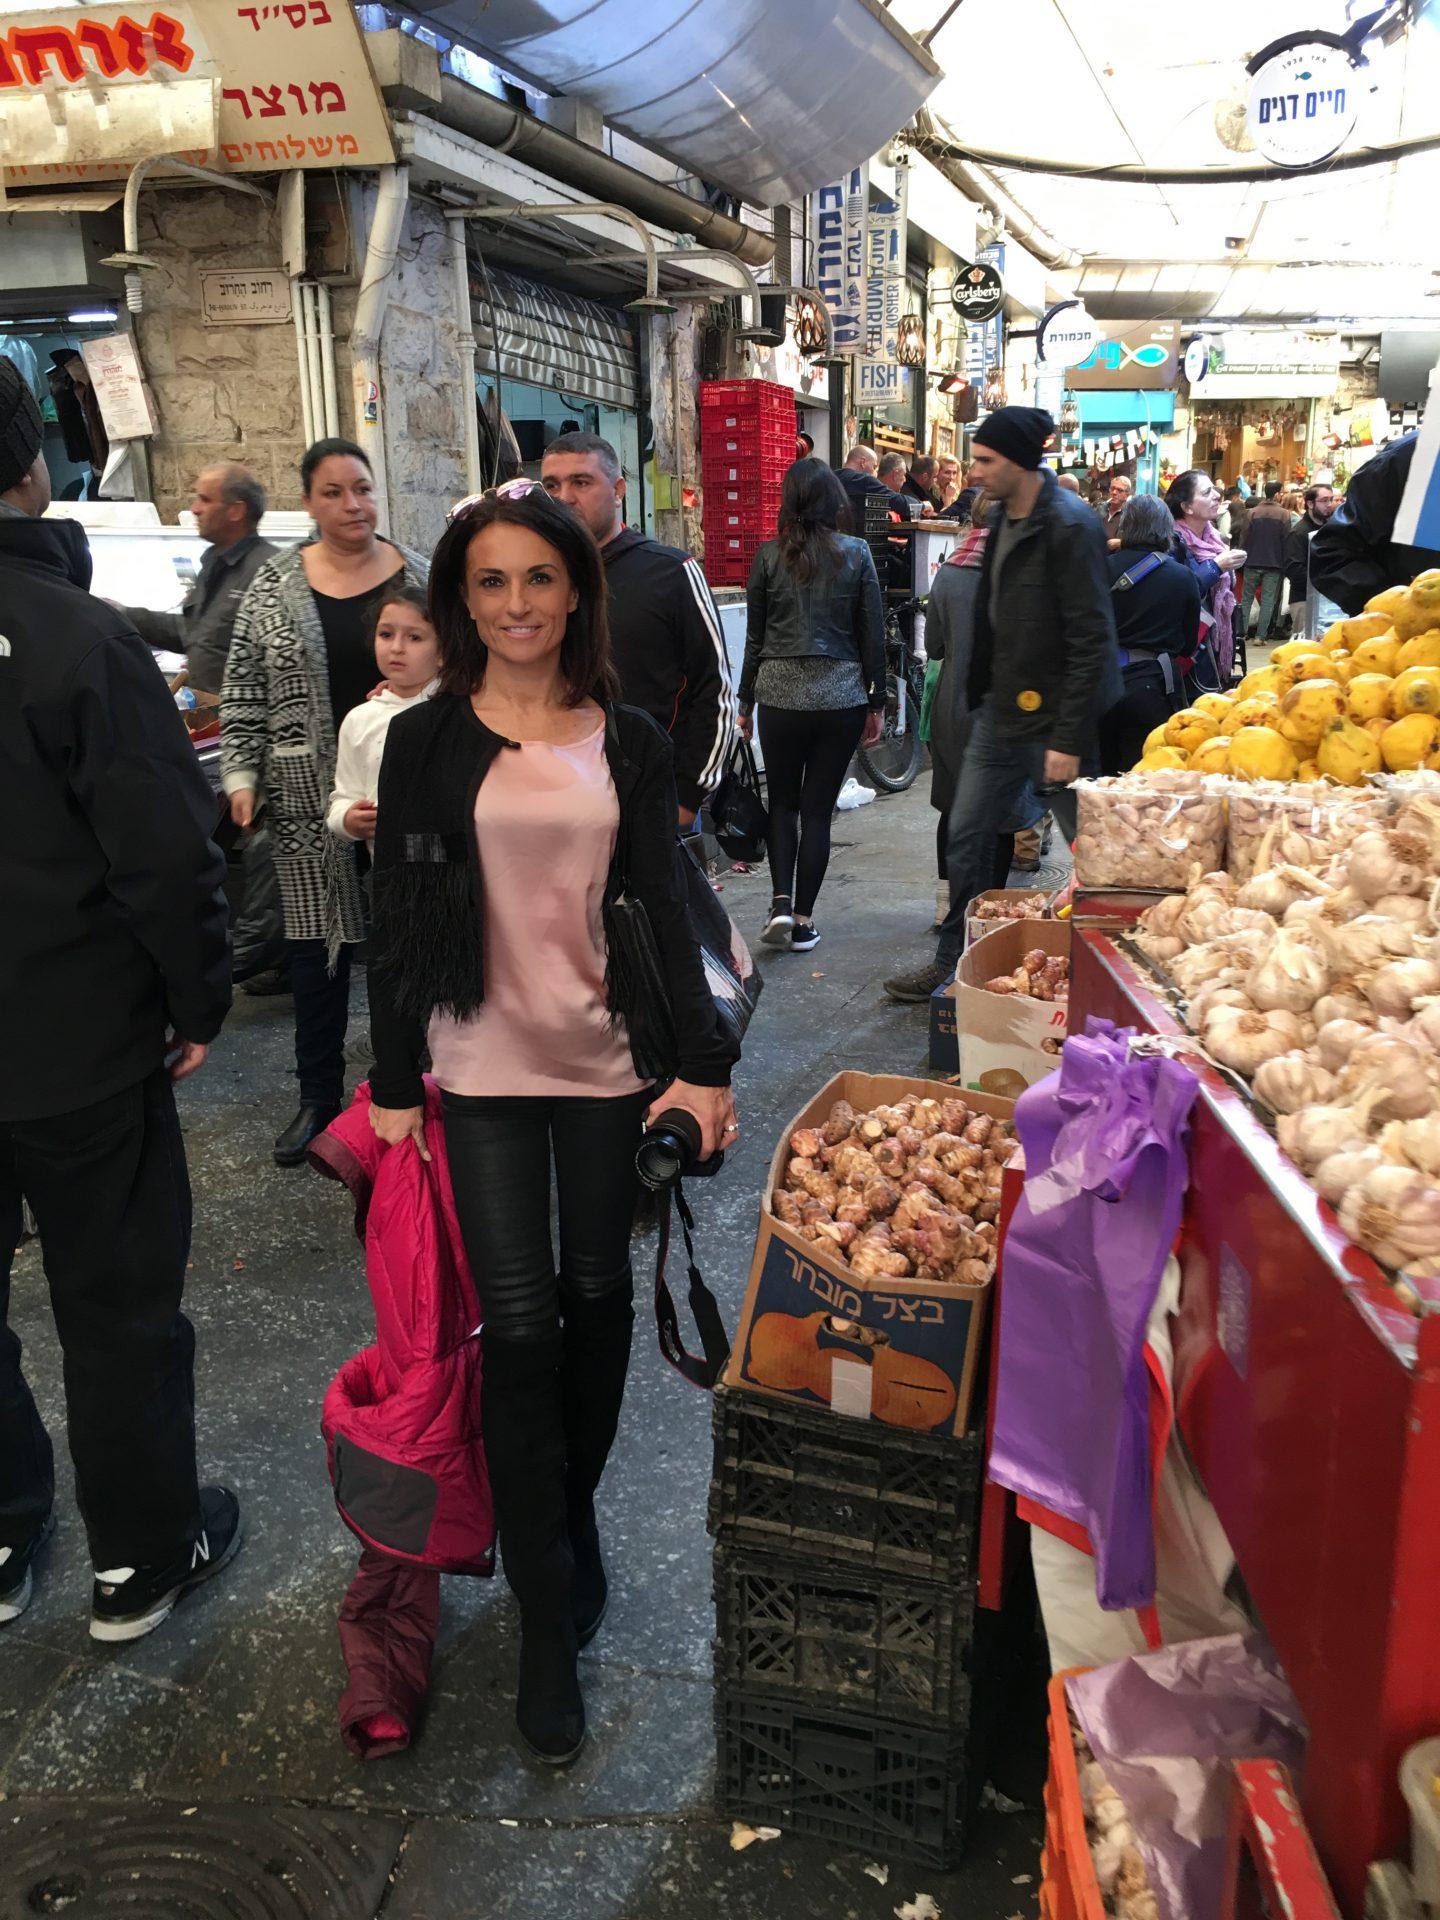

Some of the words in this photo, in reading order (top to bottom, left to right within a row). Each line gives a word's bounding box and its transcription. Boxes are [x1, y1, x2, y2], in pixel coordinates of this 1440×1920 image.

[1259, 94, 1300, 124] דגים
[1305, 88, 1346, 118] חיים
[220, 133, 359, 163] משלוחים
[885, 284, 899, 329] KOSHER
[952, 282, 1001, 302] Carlsberg
[1049, 331, 1092, 343] מכמורת
[861, 364, 898, 389] FISH
[784, 1249, 863, 1318] מובחר
[872, 1294, 945, 1324] בצל
